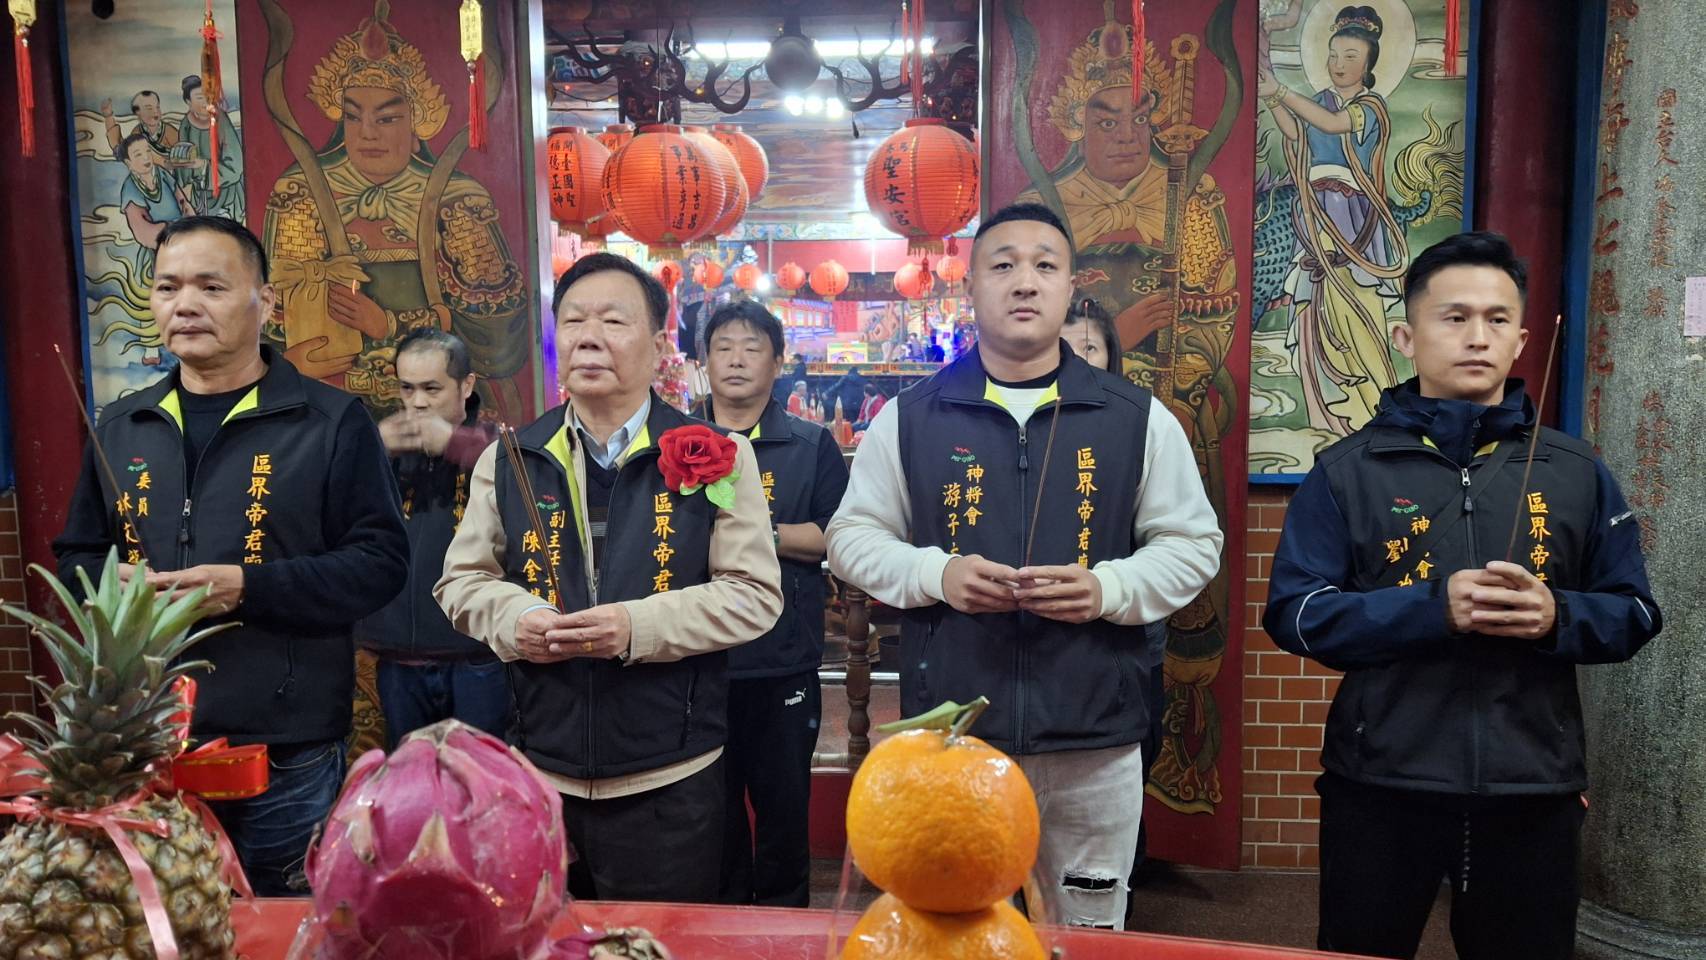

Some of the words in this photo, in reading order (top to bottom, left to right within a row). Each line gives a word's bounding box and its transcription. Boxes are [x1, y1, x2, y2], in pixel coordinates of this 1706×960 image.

[135, 471, 153, 517] 委員
[762, 472, 775, 516] 區界
[963, 464, 985, 527] 神將會
[652, 492, 676, 593] 區界帝君
[1410, 515, 1435, 580] 神會
